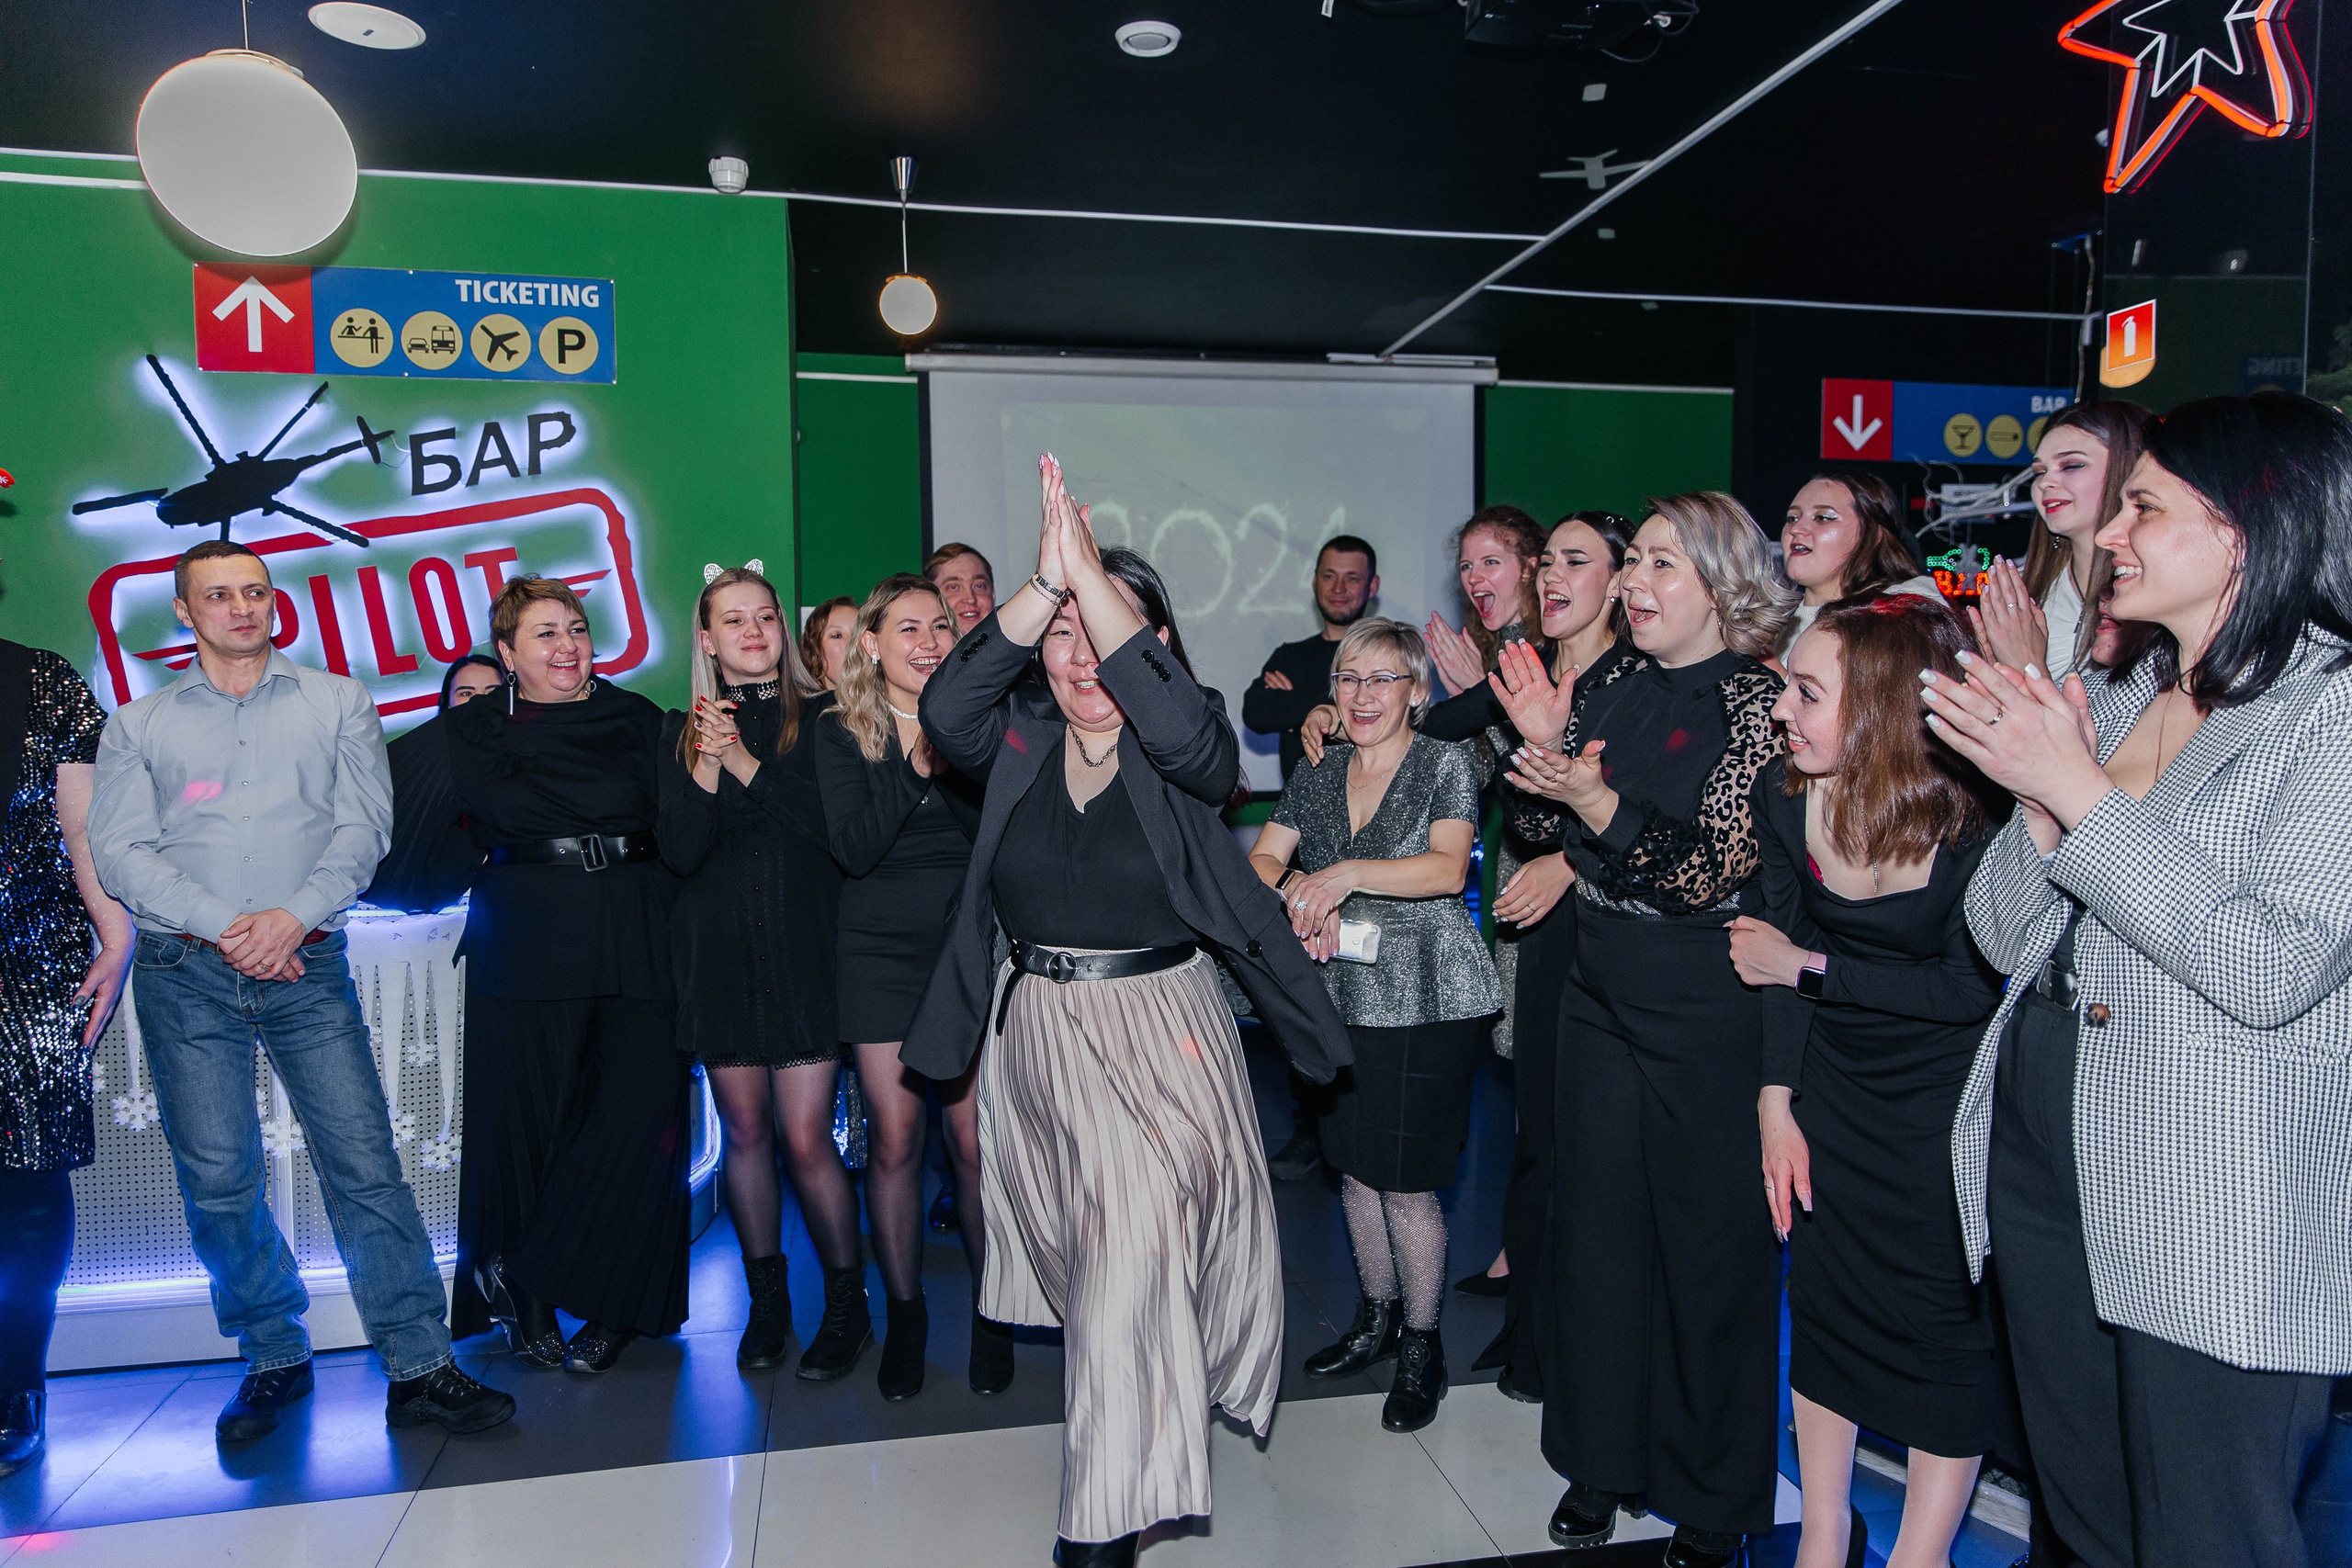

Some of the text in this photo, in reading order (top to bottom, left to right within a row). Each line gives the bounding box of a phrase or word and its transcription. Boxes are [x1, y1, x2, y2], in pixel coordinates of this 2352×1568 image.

[455, 279, 600, 308] TICKETING
[557, 328, 586, 364] P
[409, 411, 577, 496] БАР
